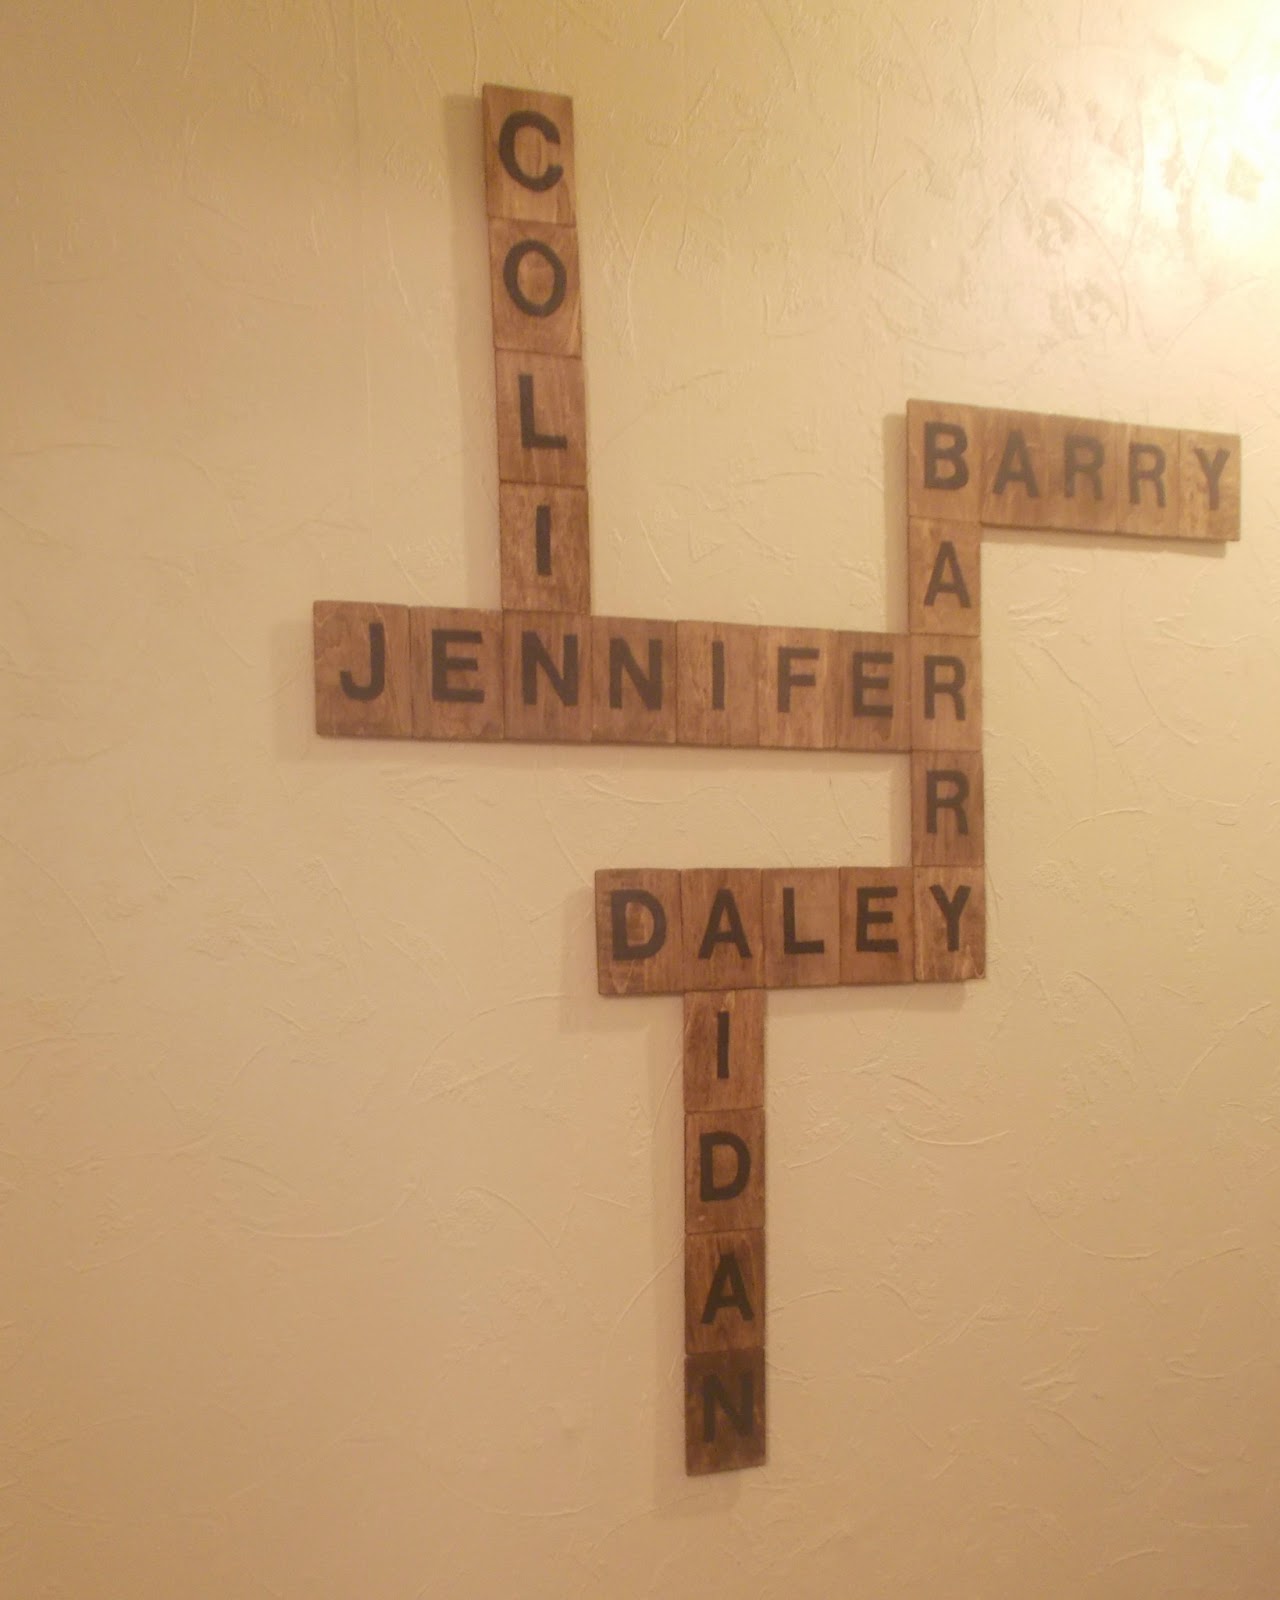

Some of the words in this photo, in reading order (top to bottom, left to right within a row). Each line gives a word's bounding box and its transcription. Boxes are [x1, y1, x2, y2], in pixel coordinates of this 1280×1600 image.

[498, 110, 578, 706] COLIN
[923, 421, 1230, 511] BARRY
[340, 622, 967, 721] JENNIFER
[922, 421, 972, 951] BARRY
[610, 884, 971, 961] DALEY
[698, 888, 754, 1444] AIDAN
